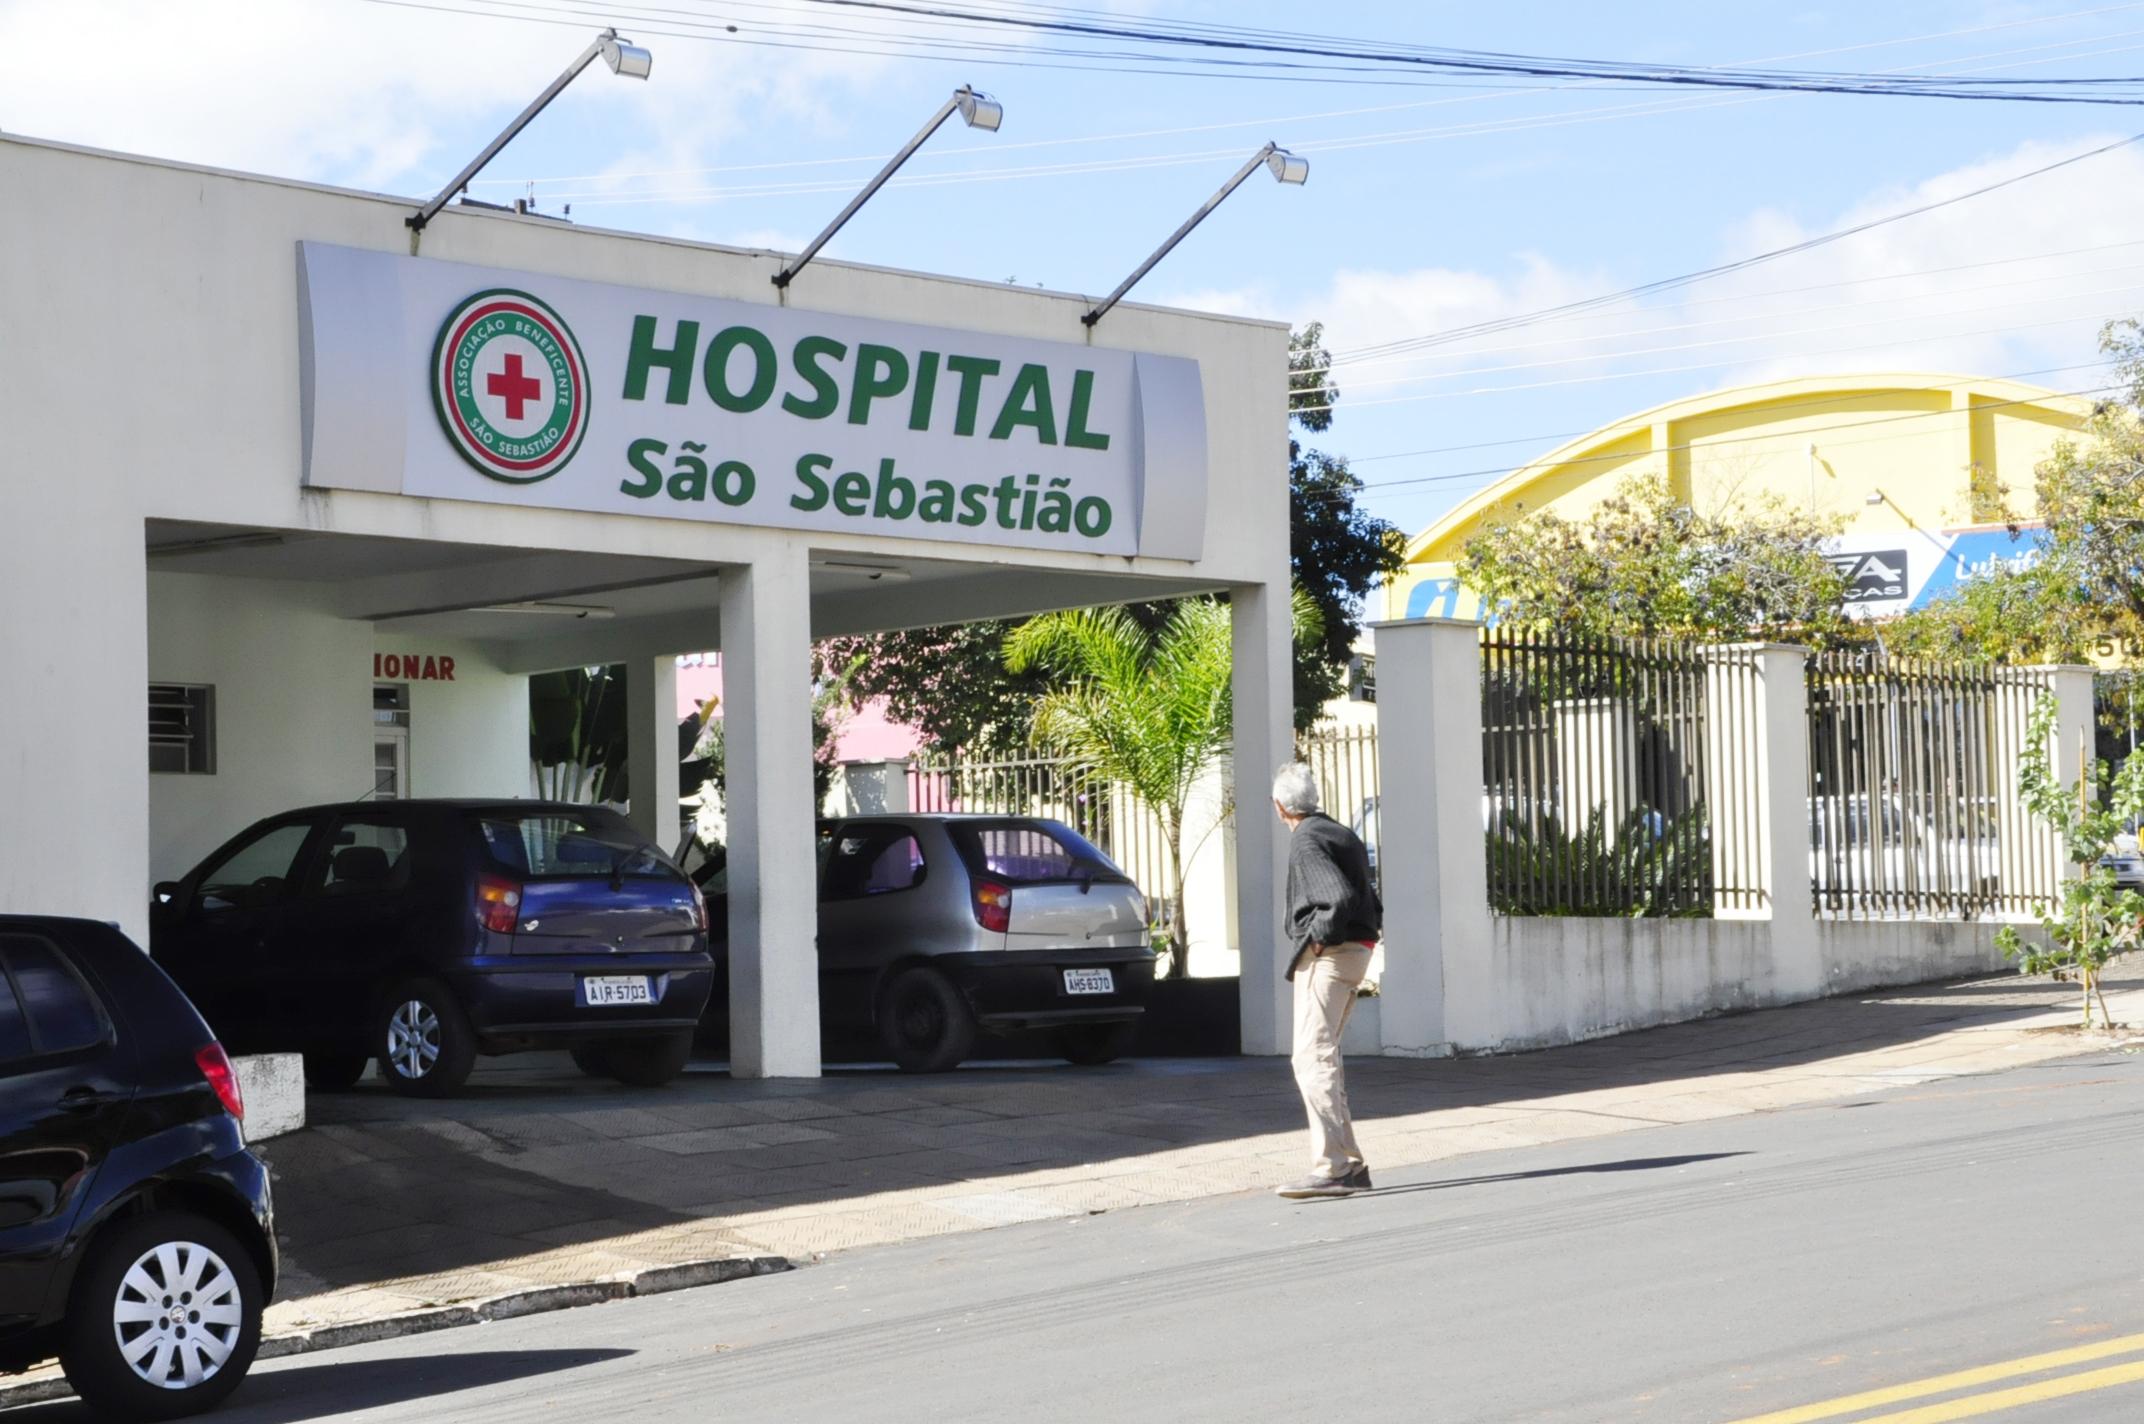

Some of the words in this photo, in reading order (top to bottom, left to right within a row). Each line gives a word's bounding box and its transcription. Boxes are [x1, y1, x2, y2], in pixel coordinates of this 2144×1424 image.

[515, 320, 569, 407] BENEFICENTE
[622, 314, 1111, 451] HOSPITAL
[620, 438, 756, 506] São
[789, 453, 1112, 538] Sebastião
